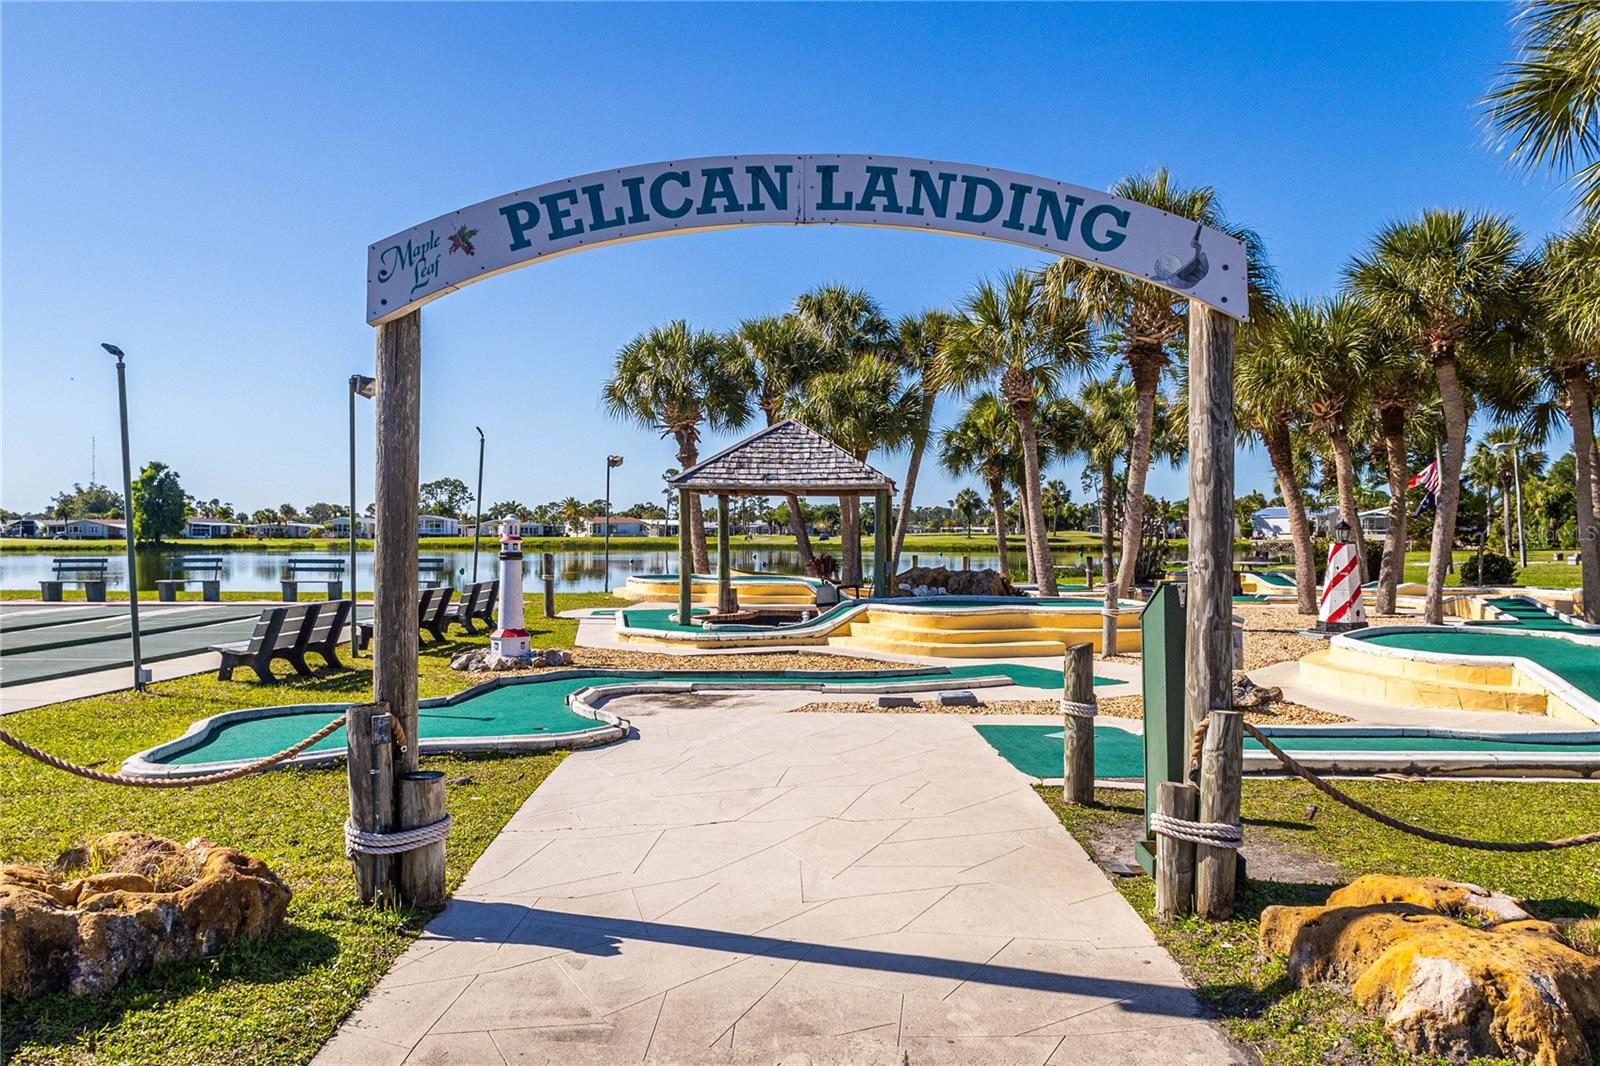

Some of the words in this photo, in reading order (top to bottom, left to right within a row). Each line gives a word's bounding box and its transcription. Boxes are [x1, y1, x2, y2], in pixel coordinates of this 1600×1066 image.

[498, 164, 793, 252] PELICAN
[815, 165, 1131, 252] LANDING
[378, 230, 440, 283] Maple
[410, 255, 442, 294] Leaf
